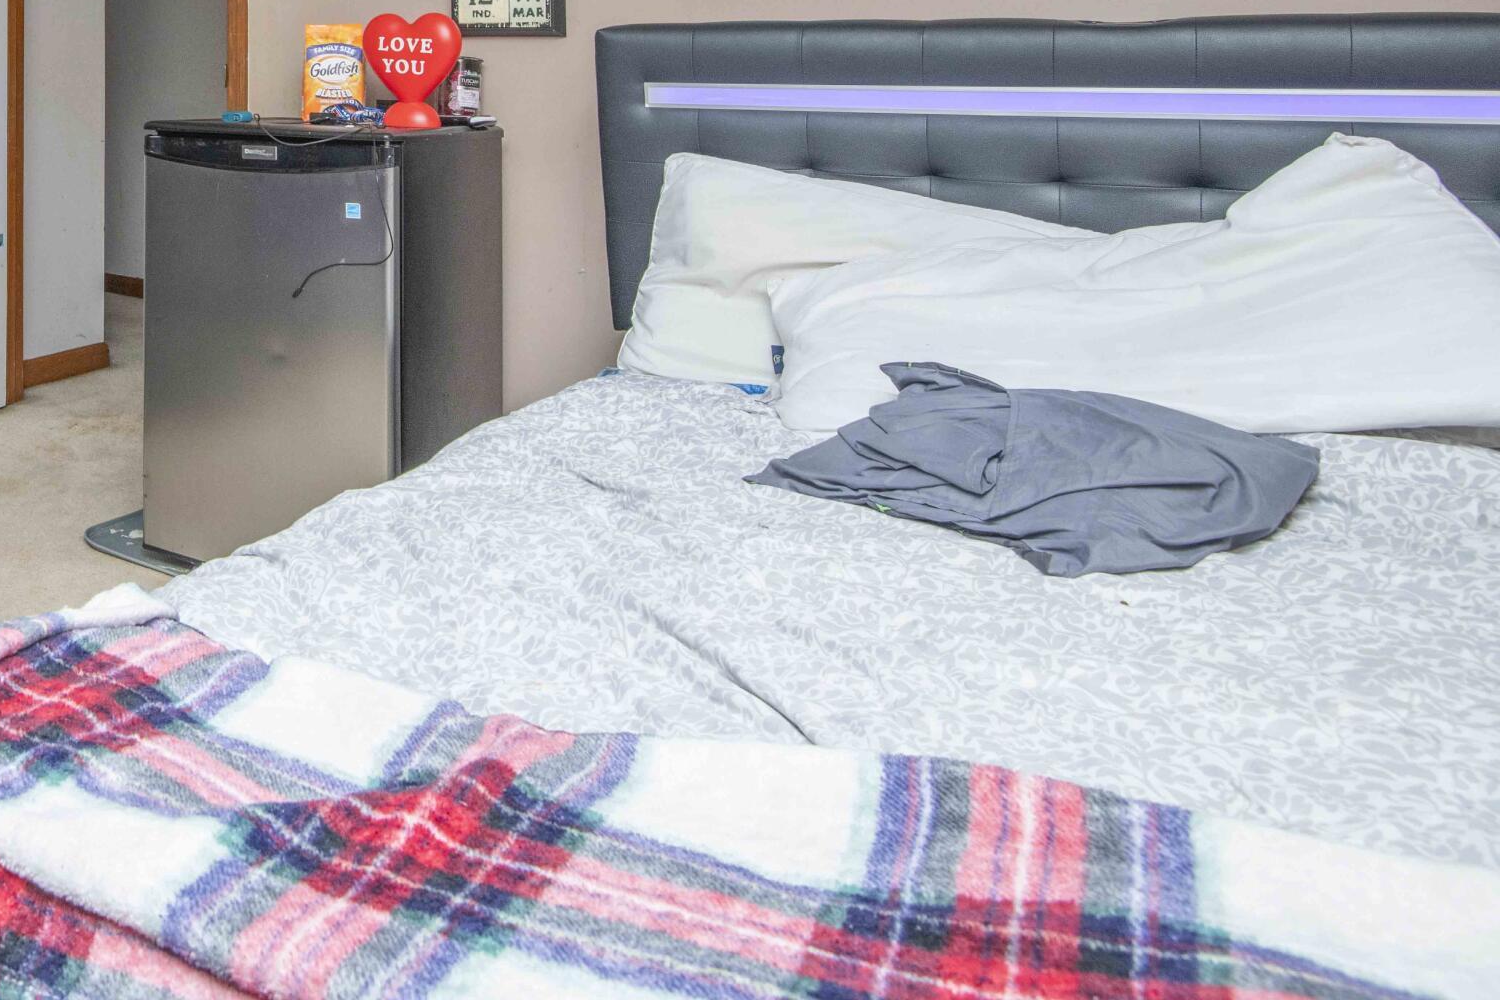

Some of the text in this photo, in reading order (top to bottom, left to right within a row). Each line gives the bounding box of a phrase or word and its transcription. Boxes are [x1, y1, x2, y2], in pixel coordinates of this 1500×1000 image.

[512, 7, 544, 19] MAR
[314, 45, 356, 55] FAMILY SIZE
[377, 36, 433, 54] LOVE
[310, 61, 359, 78] Goldfish
[381, 58, 426, 76] YOU
